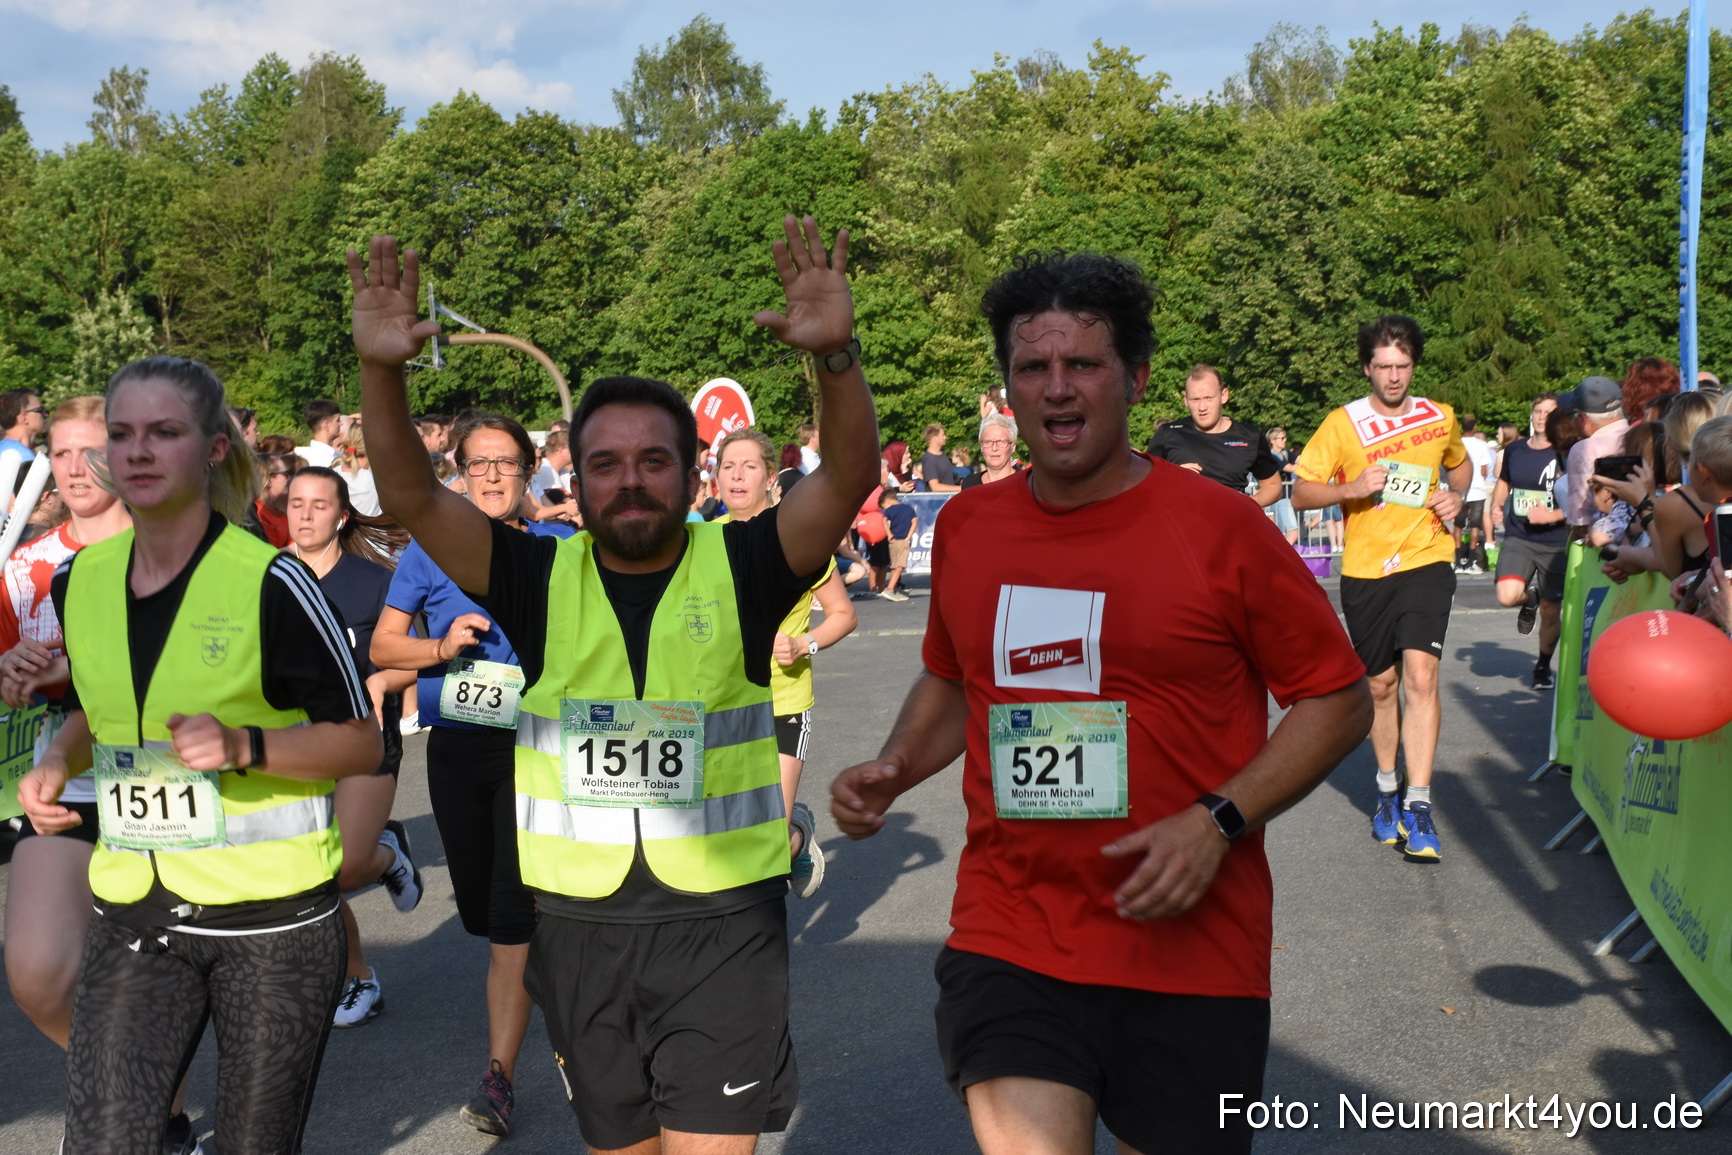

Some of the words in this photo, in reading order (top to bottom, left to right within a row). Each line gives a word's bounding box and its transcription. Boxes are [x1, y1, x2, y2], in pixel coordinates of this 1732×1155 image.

[1366, 440, 1407, 464] MAX
[1410, 426, 1448, 446] BÖGL
[1029, 648, 1063, 666] DEHN
[456, 681, 503, 709] 873
[454, 703, 477, 713] Wehera
[478, 707, 501, 717] Marion
[580, 720, 636, 732] firmenlauf
[668, 729, 694, 739] 2019
[1088, 733, 1117, 743] 2019
[578, 738, 683, 778] 1518
[1012, 745, 1084, 786] 521
[581, 777, 640, 789] Wolfsteiner
[643, 779, 680, 789] Tobias
[590, 789, 609, 797] Markt
[610, 790, 669, 799] Postbauer-Heng
[1011, 788, 1047, 799] Mohren
[1050, 788, 1094, 798] Michael
[110, 783, 197, 820] 1511
[1018, 800, 1037, 808] DEHN
[124, 821, 147, 831] Gnan
[149, 822, 187, 831] Jasmin
